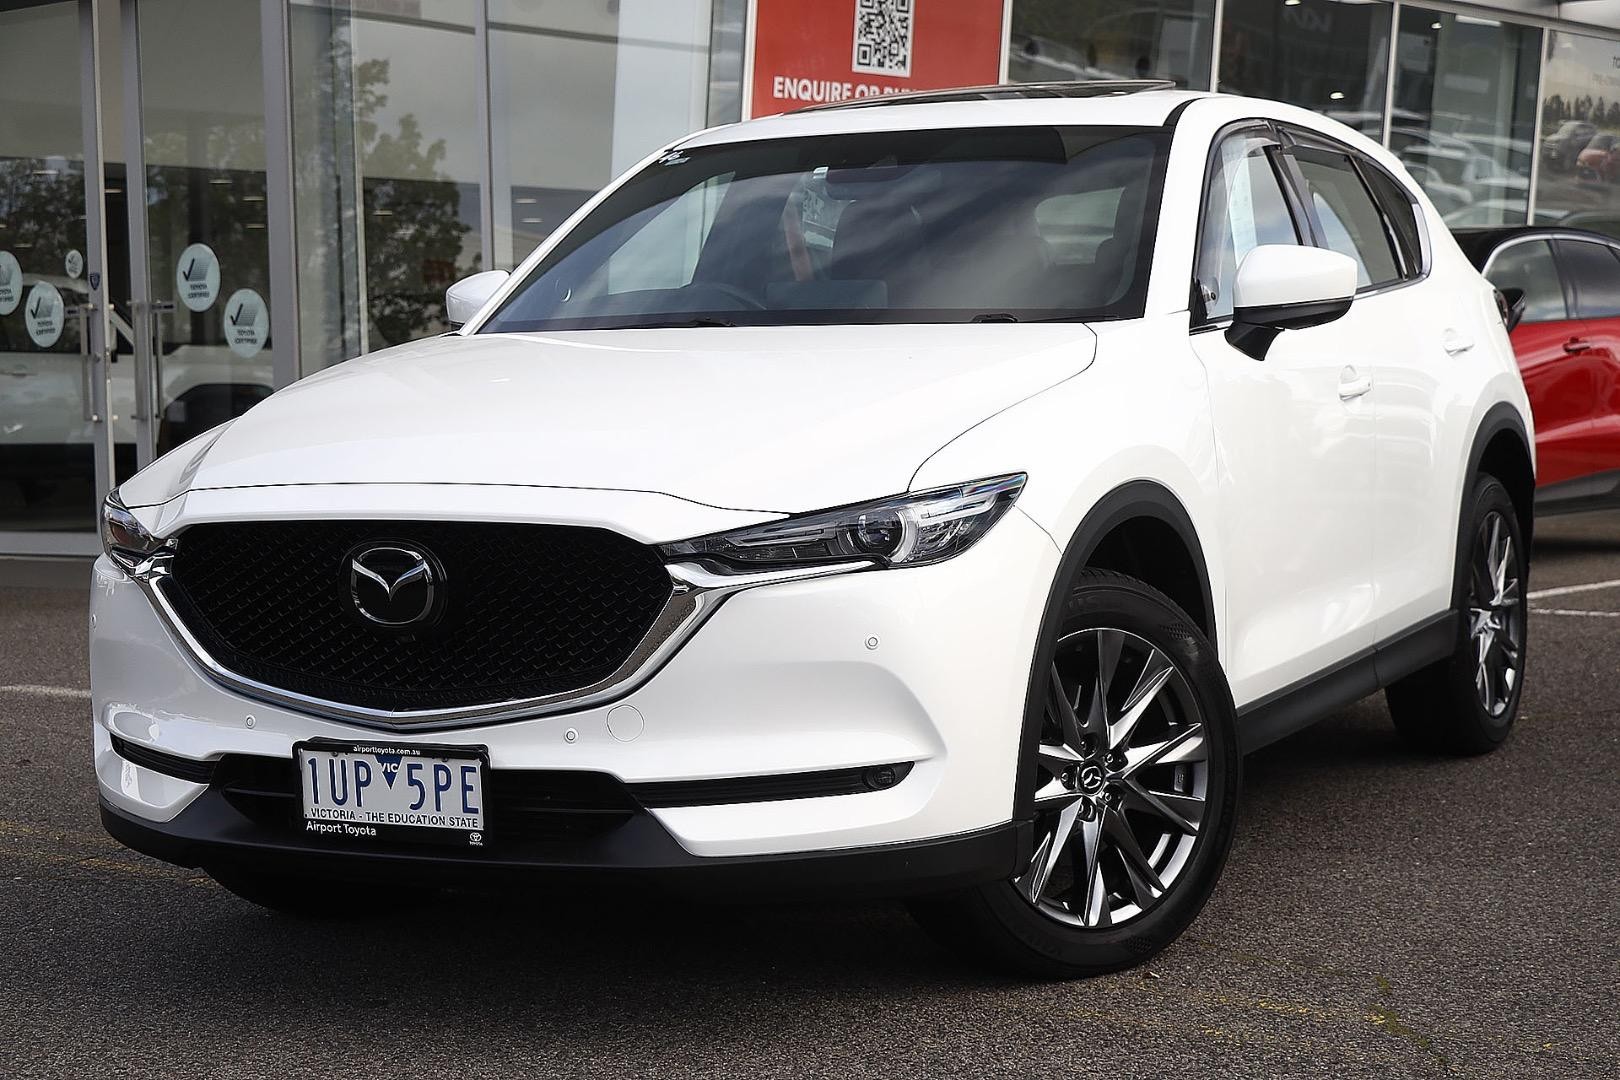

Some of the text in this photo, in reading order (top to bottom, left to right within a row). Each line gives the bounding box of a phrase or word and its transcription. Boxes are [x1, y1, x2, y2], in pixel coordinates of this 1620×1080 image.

[773, 76, 852, 101] ENQUIRE
[353, 745, 421, 755] airporttoyota.com.au
[381, 762, 399, 773] VIC
[308, 758, 480, 814] 1UP 5PE
[311, 808, 356, 820] VICTORIA
[365, 812, 385, 823] THE
[388, 813, 446, 826] EDUCATION
[449, 817, 479, 828] STATE
[306, 821, 377, 837] Airport Toyota
